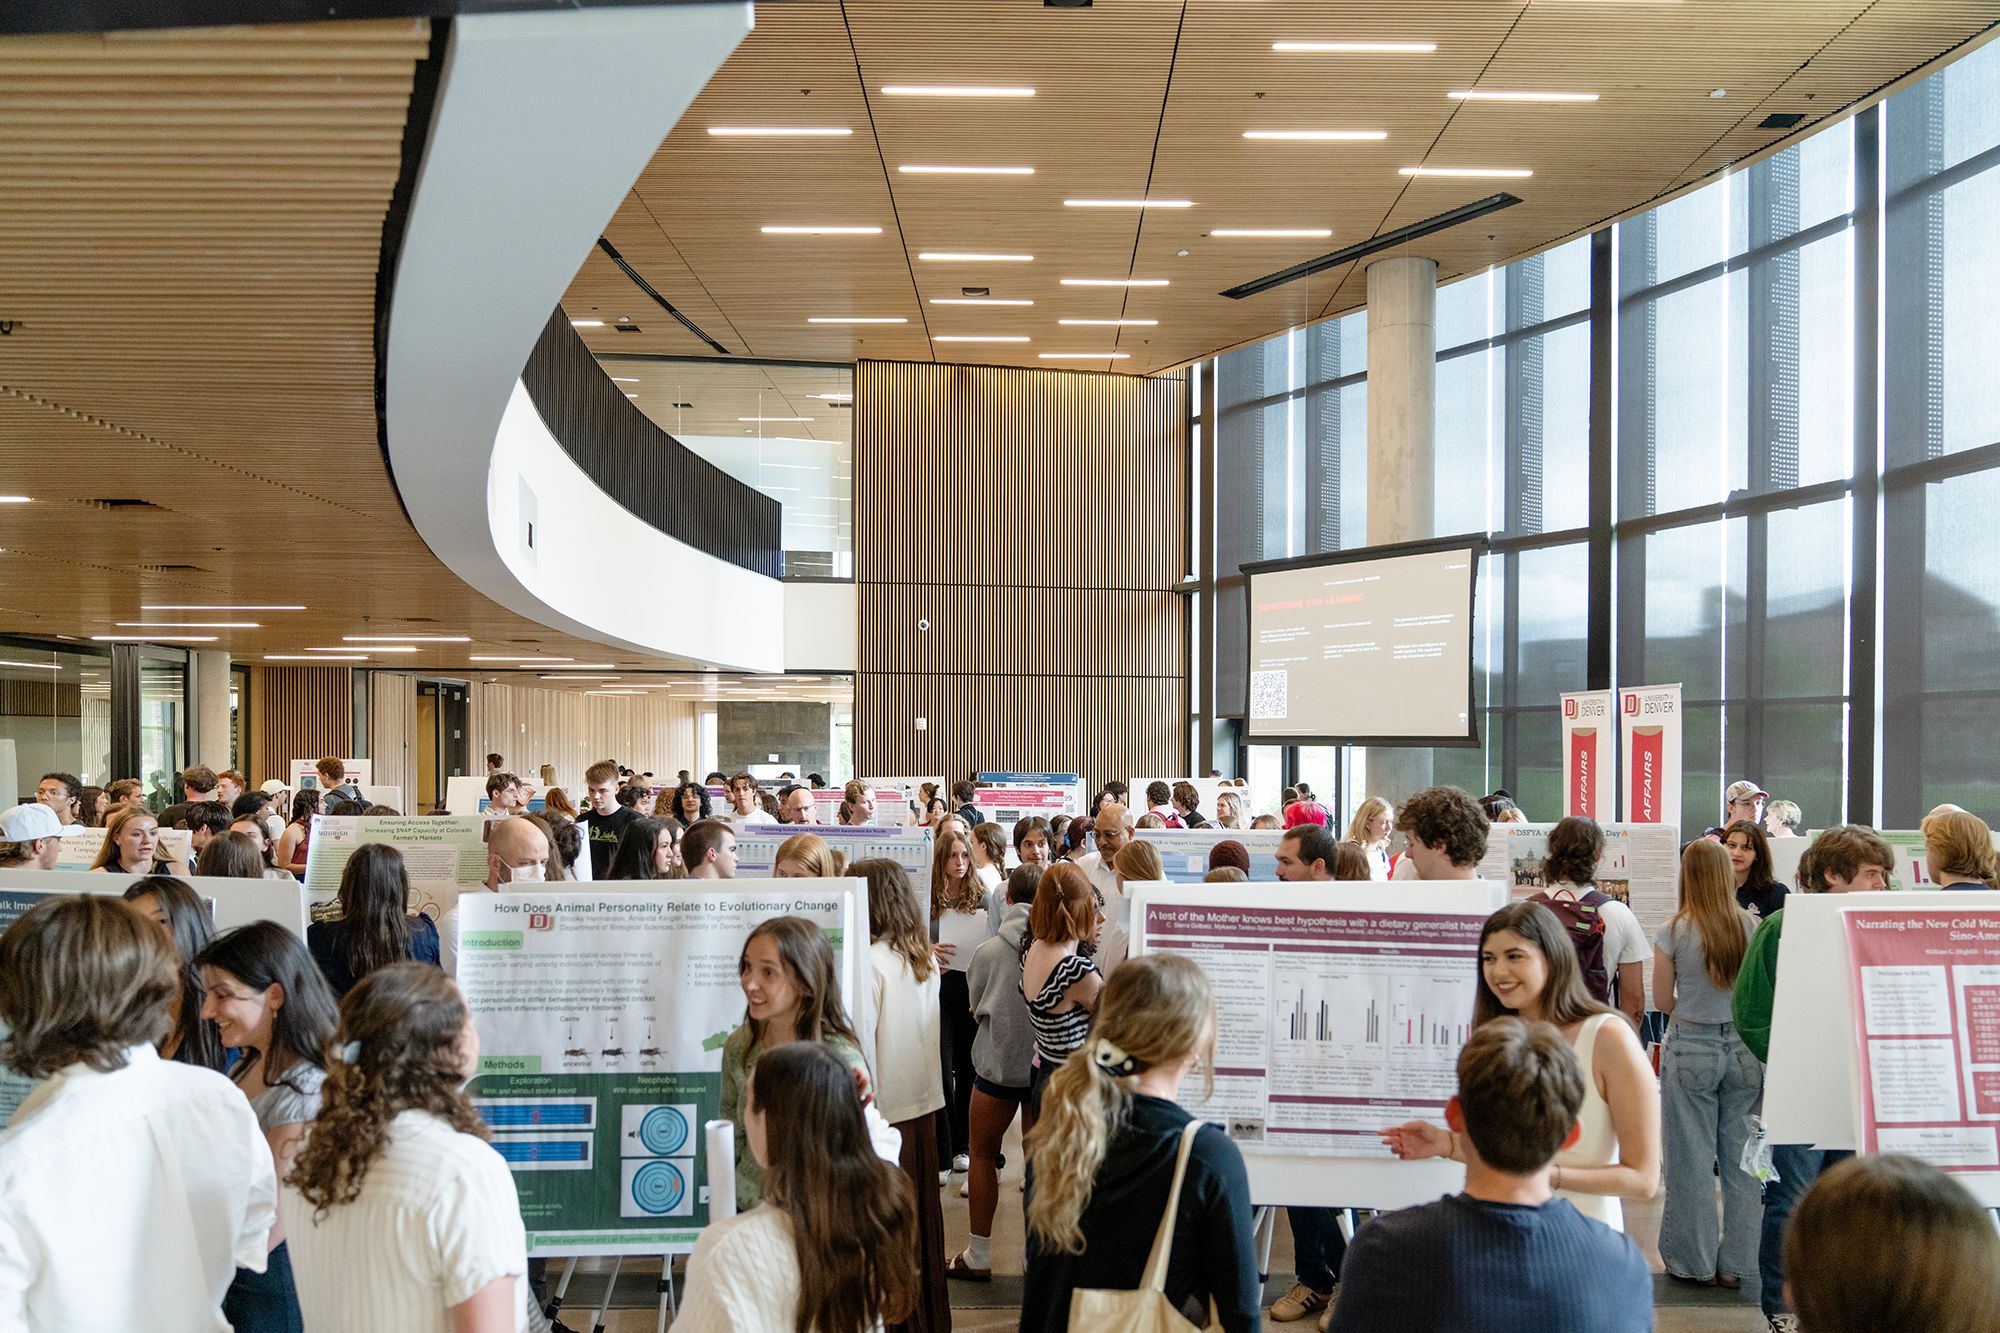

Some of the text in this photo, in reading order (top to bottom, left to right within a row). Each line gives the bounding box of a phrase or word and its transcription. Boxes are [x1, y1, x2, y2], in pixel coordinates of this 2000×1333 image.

[1581, 706, 1605, 717] DENVER
[1645, 702, 1674, 714] DENVER
[1580, 750, 1588, 814] AFFAIRS
[1643, 751, 1653, 821] AFFAIRS
[379, 819, 406, 827] Ensuring
[1516, 829, 1542, 837] DSFYA
[1605, 830, 1621, 838] Day
[494, 901, 838, 914] How Does Animal Personality Relate to Evolutionary Change
[1149, 910, 1158, 920] A
[1158, 911, 1177, 920] test
[1177, 911, 1190, 921] of
[1189, 912, 1205, 921] the
[1207, 912, 1240, 923] Mother
[1242, 914, 1273, 924] knows
[1274, 914, 1295, 924] best
[1296, 915, 1347, 927] hypothesis
[1349, 918, 1368, 927] with
[1378, 919, 1411, 930] dietary
[1412, 920, 1458, 931] generalist
[1856, 918, 1976, 931] Narrating the New Cold
[463, 938, 521, 947] Introduction
[484, 1060, 525, 1069] Methods
[510, 1076, 552, 1086] Exploration
[637, 1076, 678, 1084] Neophobia
